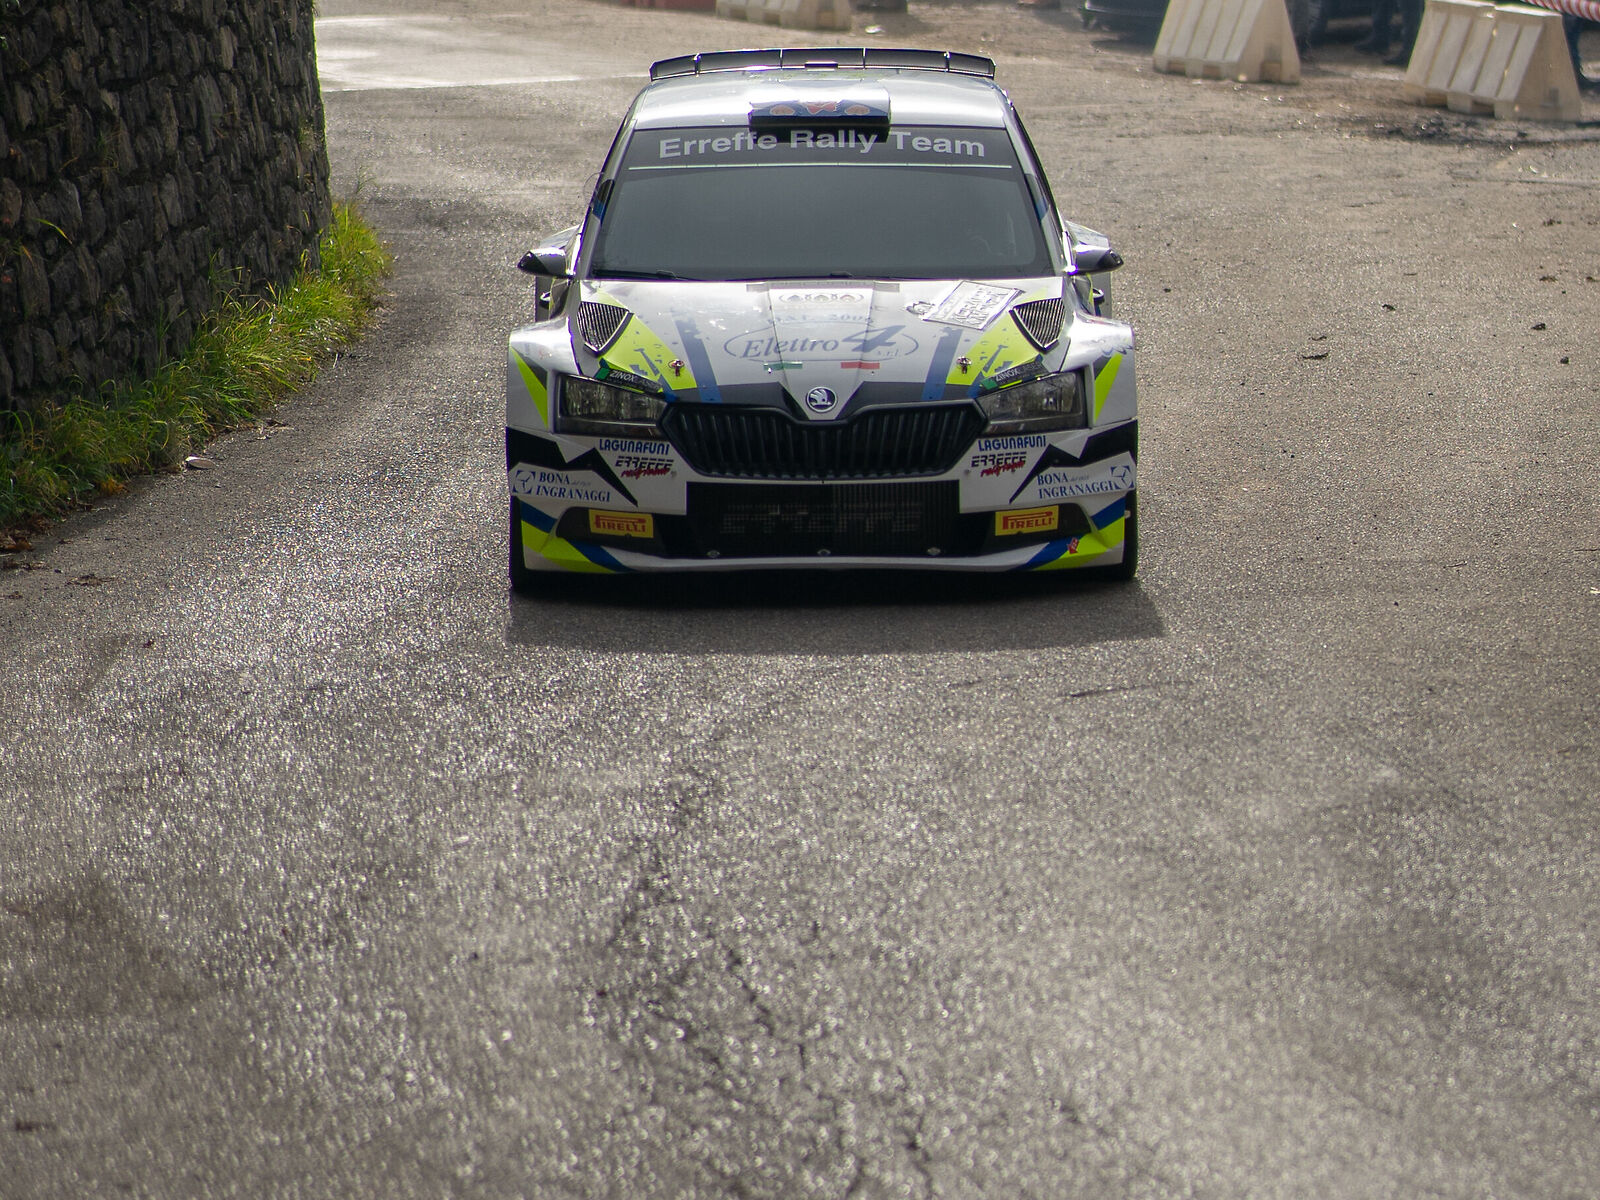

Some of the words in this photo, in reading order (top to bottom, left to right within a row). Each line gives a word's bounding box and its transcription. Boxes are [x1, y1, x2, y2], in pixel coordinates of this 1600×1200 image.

[659, 130, 778, 159] Erreffe
[790, 129, 878, 153] Rally
[890, 131, 985, 157] Team
[739, 335, 839, 359] Elettro
[842, 325, 906, 353] 4
[600, 438, 670, 455] LAGUNAFUNI
[978, 435, 1046, 451] LAGUNAFUNI
[539, 471, 570, 485] BONA
[1037, 472, 1069, 486] BONA
[536, 485, 611, 503] INGRANAGGI
[1038, 480, 1115, 500] INGRANAGGI
[595, 514, 647, 533] PIRELLI
[1002, 511, 1054, 530] PIRELLI
